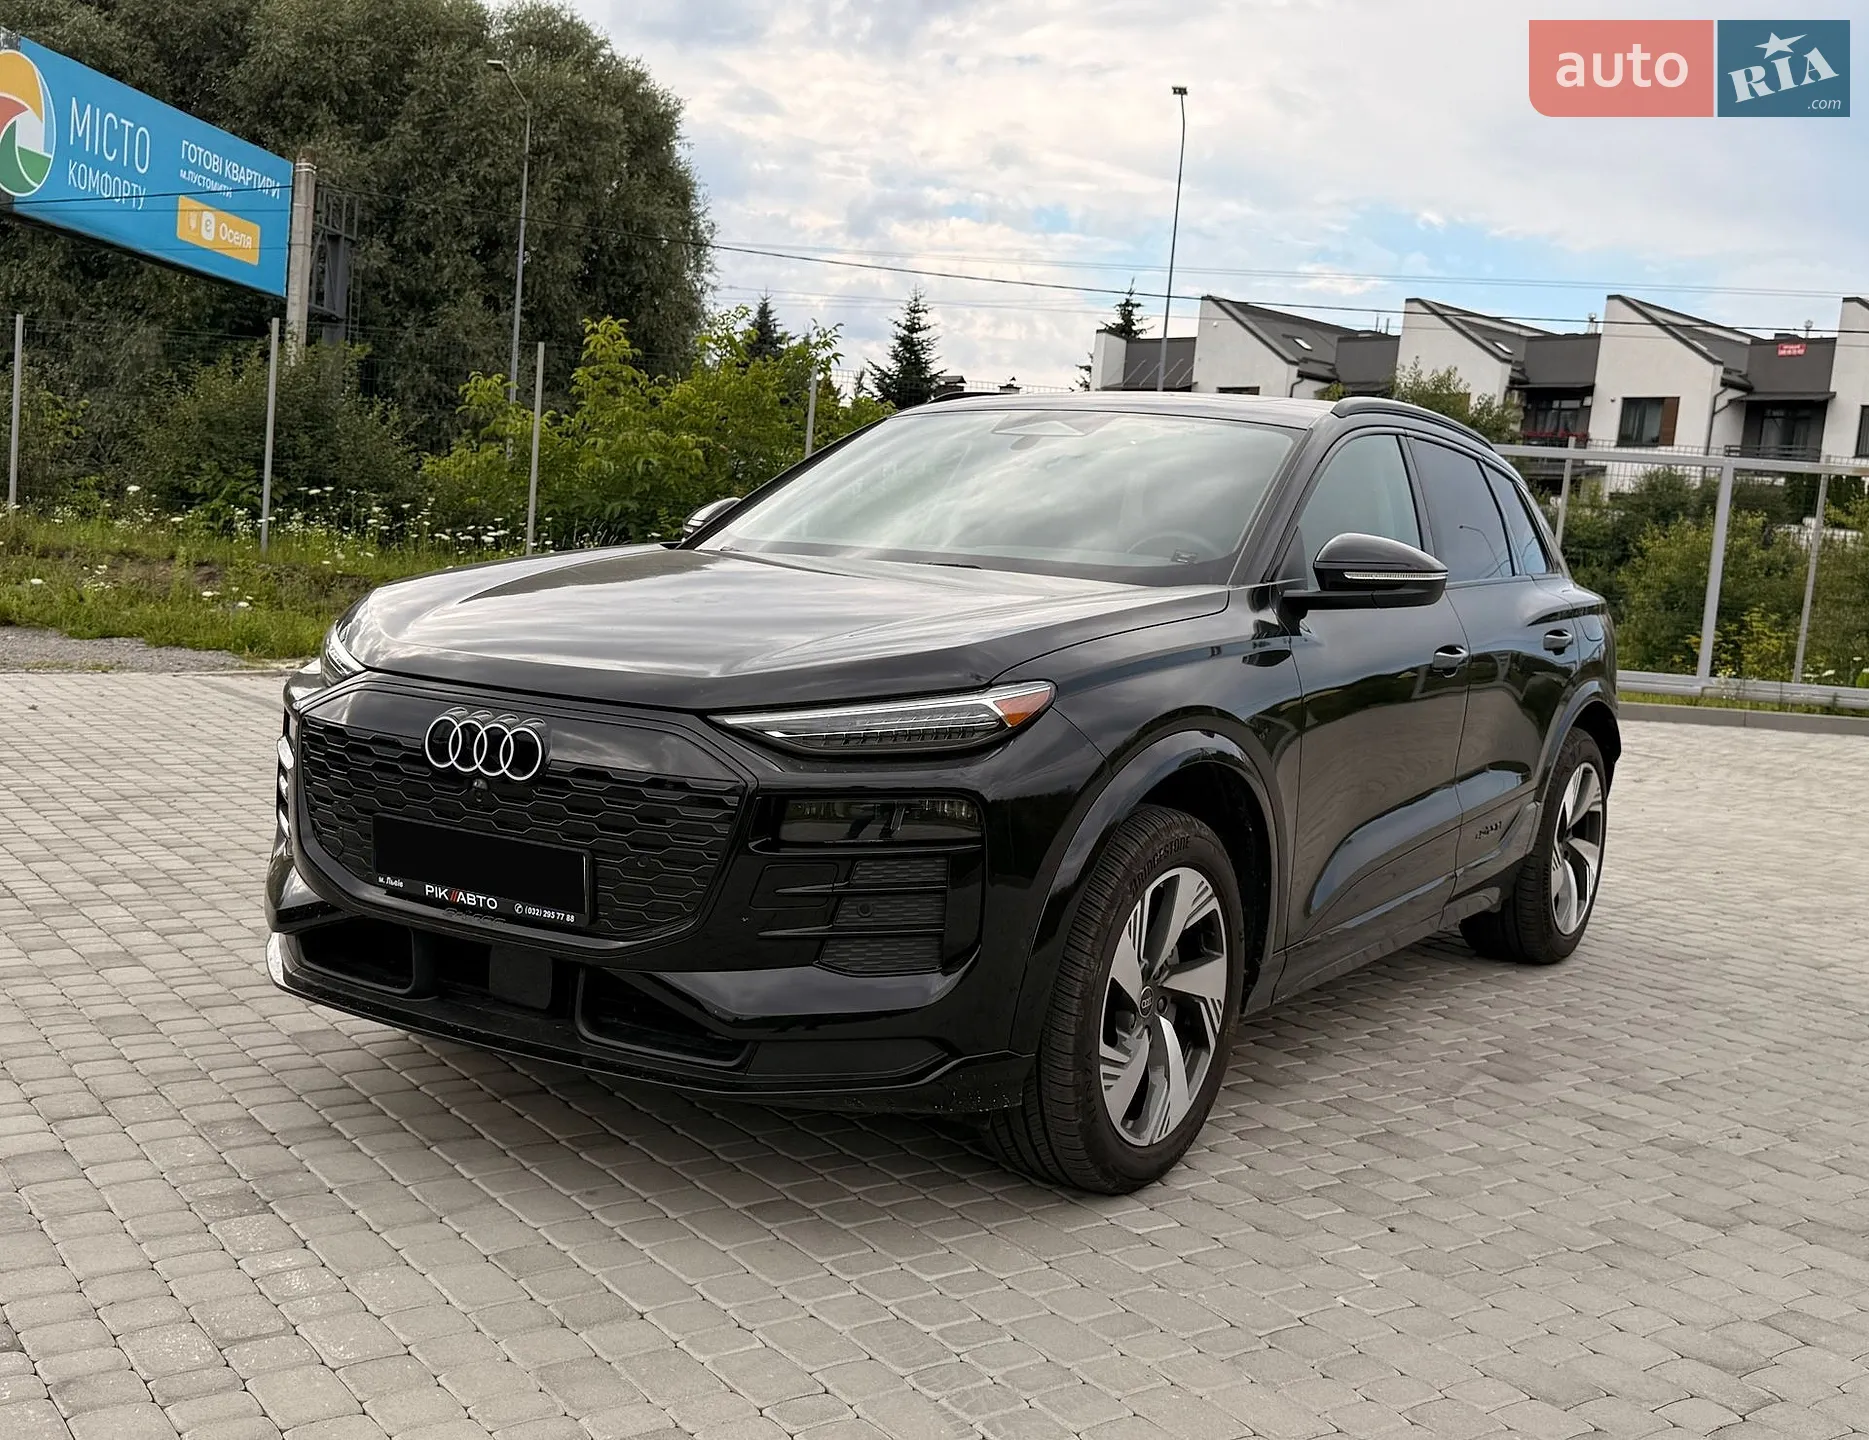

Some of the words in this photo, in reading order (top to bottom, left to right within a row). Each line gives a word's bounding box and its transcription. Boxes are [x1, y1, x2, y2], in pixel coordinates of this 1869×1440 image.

[69, 96, 151, 174] МІСТО
[68, 159, 146, 211] КОМФОРТУ
[181, 139, 223, 176] ГОТОВІ
[224, 158, 281, 200] КВАРТИРИ
[219, 222, 252, 249] Оселя
[556, 911, 565, 921] 77
